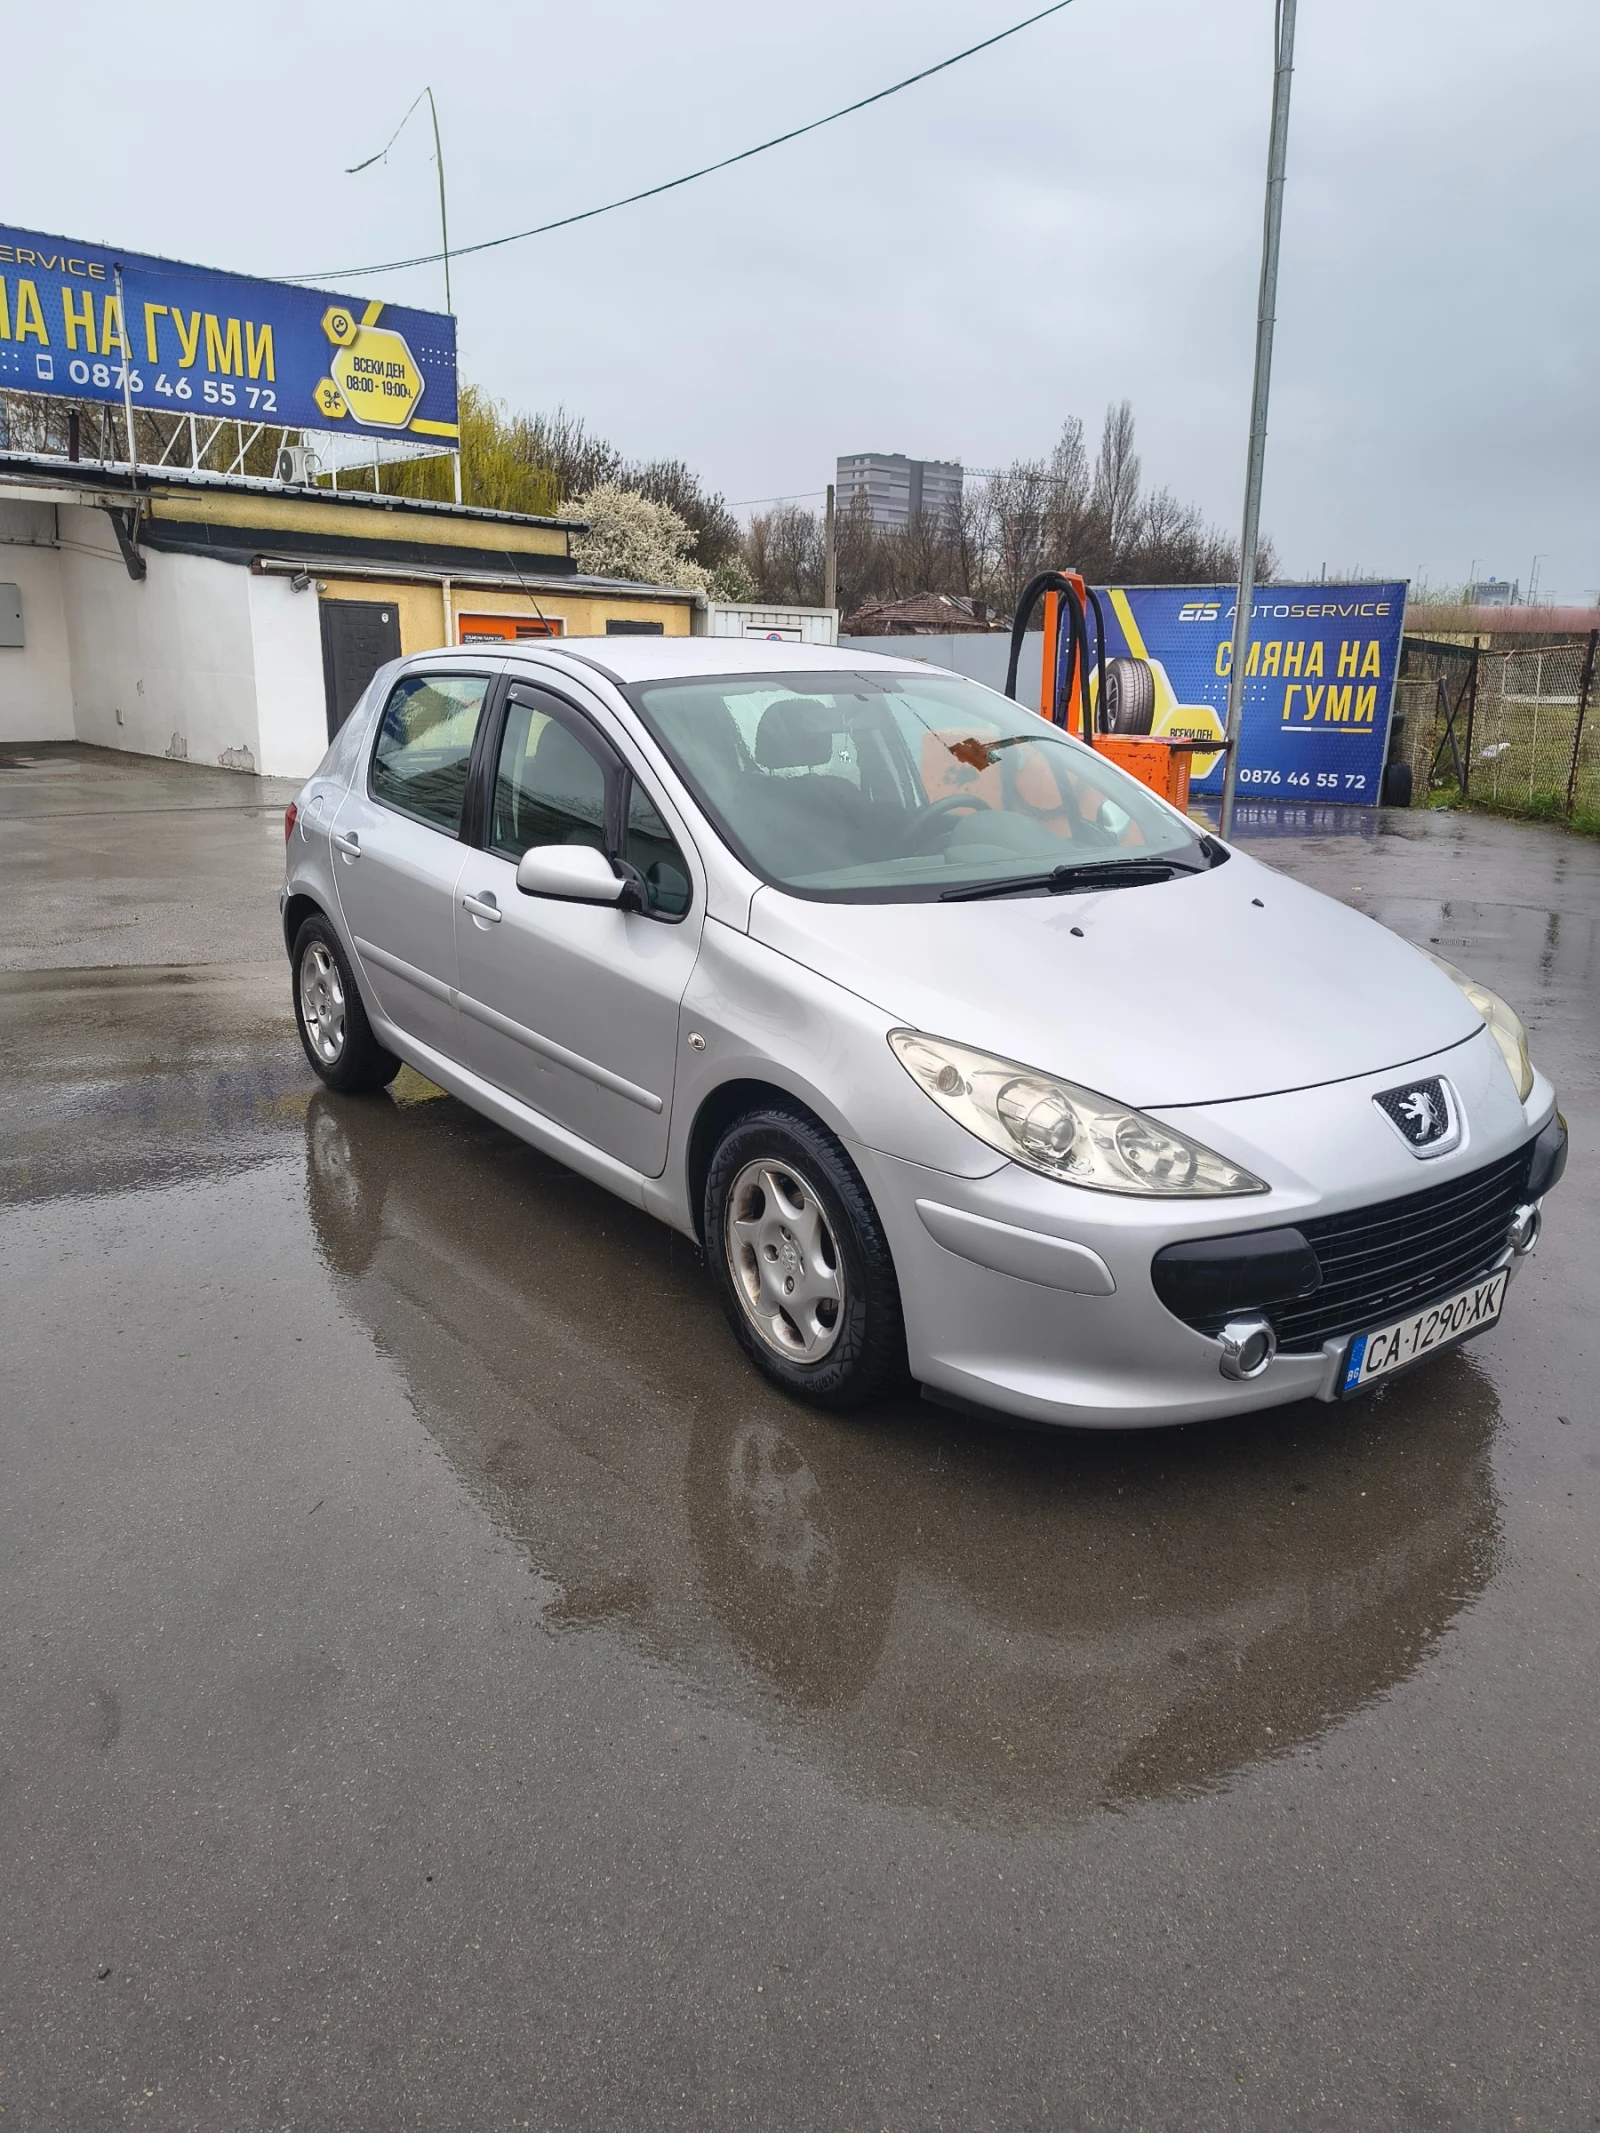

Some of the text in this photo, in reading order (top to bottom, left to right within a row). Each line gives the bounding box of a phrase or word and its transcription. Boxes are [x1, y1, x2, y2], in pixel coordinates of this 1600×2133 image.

[61, 286, 133, 360] НА
[144, 302, 276, 382] ГУМИ
[353, 356, 405, 380] ВСЕКИ ДЕН
[69, 359, 278, 413] 0876 46 55 72
[346, 374, 374, 393] 08:00
[1336, 640, 1381, 679] НА
[1282, 684, 1378, 723] ГУМИ
[1170, 727, 1196, 738] ВСЕКИ
[1239, 768, 1367, 790] 0876 46 55 72
[1346, 1366, 1360, 1382] BG
